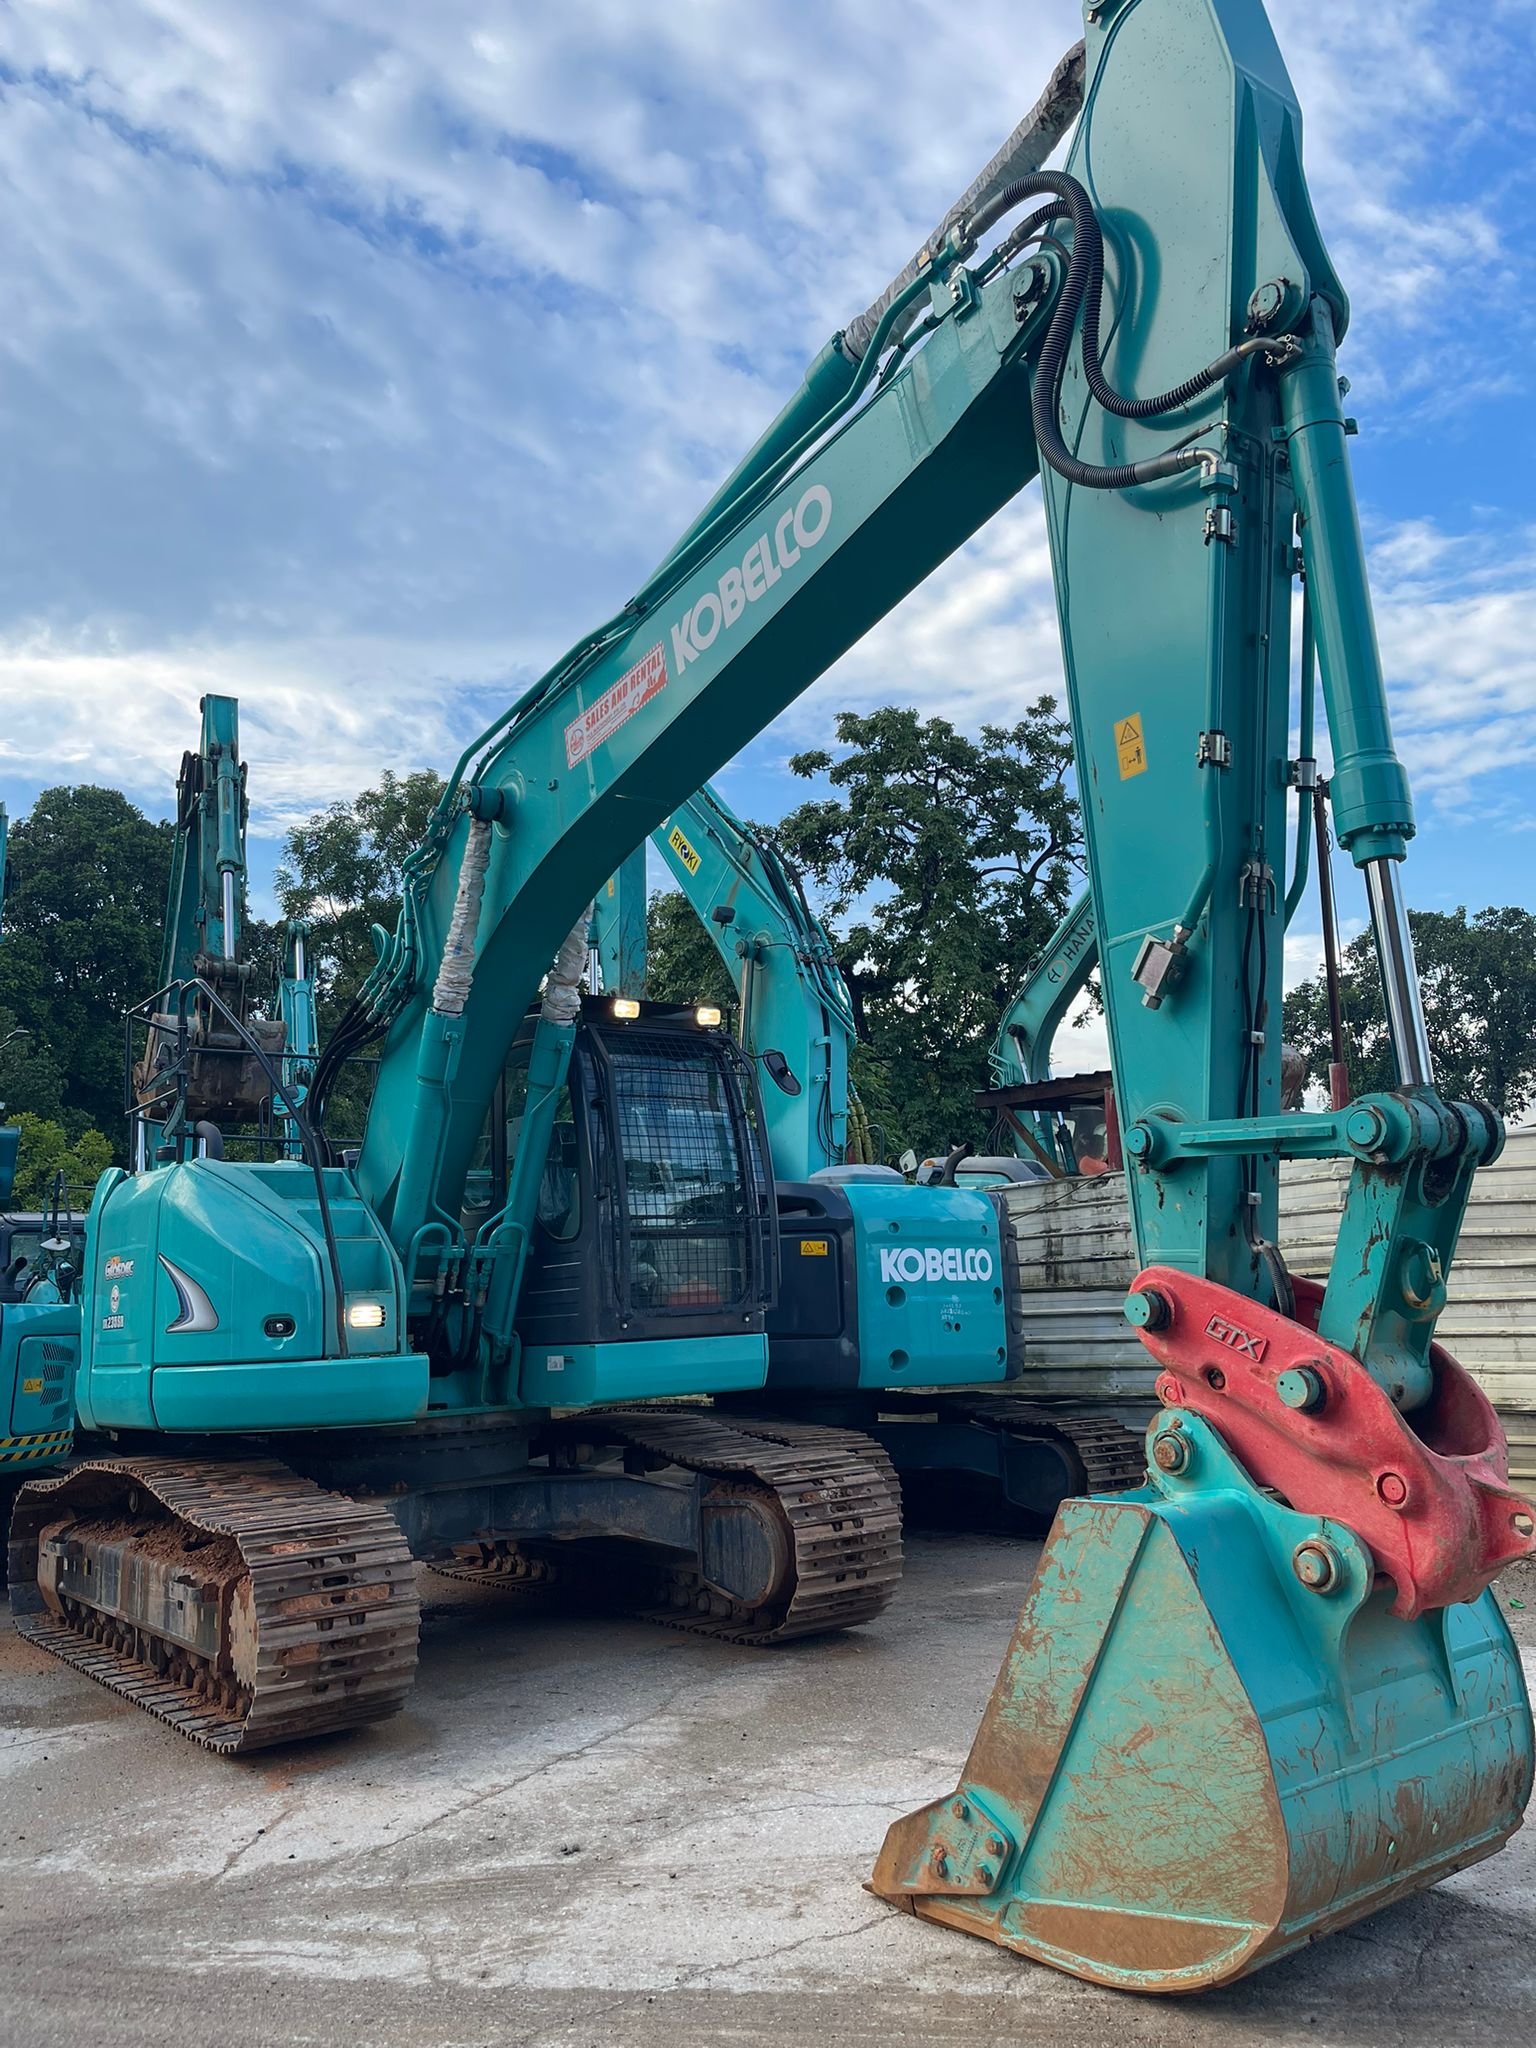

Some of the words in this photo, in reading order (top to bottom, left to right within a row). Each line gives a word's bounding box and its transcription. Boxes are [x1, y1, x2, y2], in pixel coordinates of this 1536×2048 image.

[670, 484, 832, 675] KOBELCO
[585, 698, 609, 731] SALES
[611, 682, 628, 709] AND
[630, 651, 662, 692] RENTAL
[1063, 912, 1095, 961] HANA
[880, 1248, 993, 1283] KOBELCO
[1205, 1315, 1262, 1358] GTX
